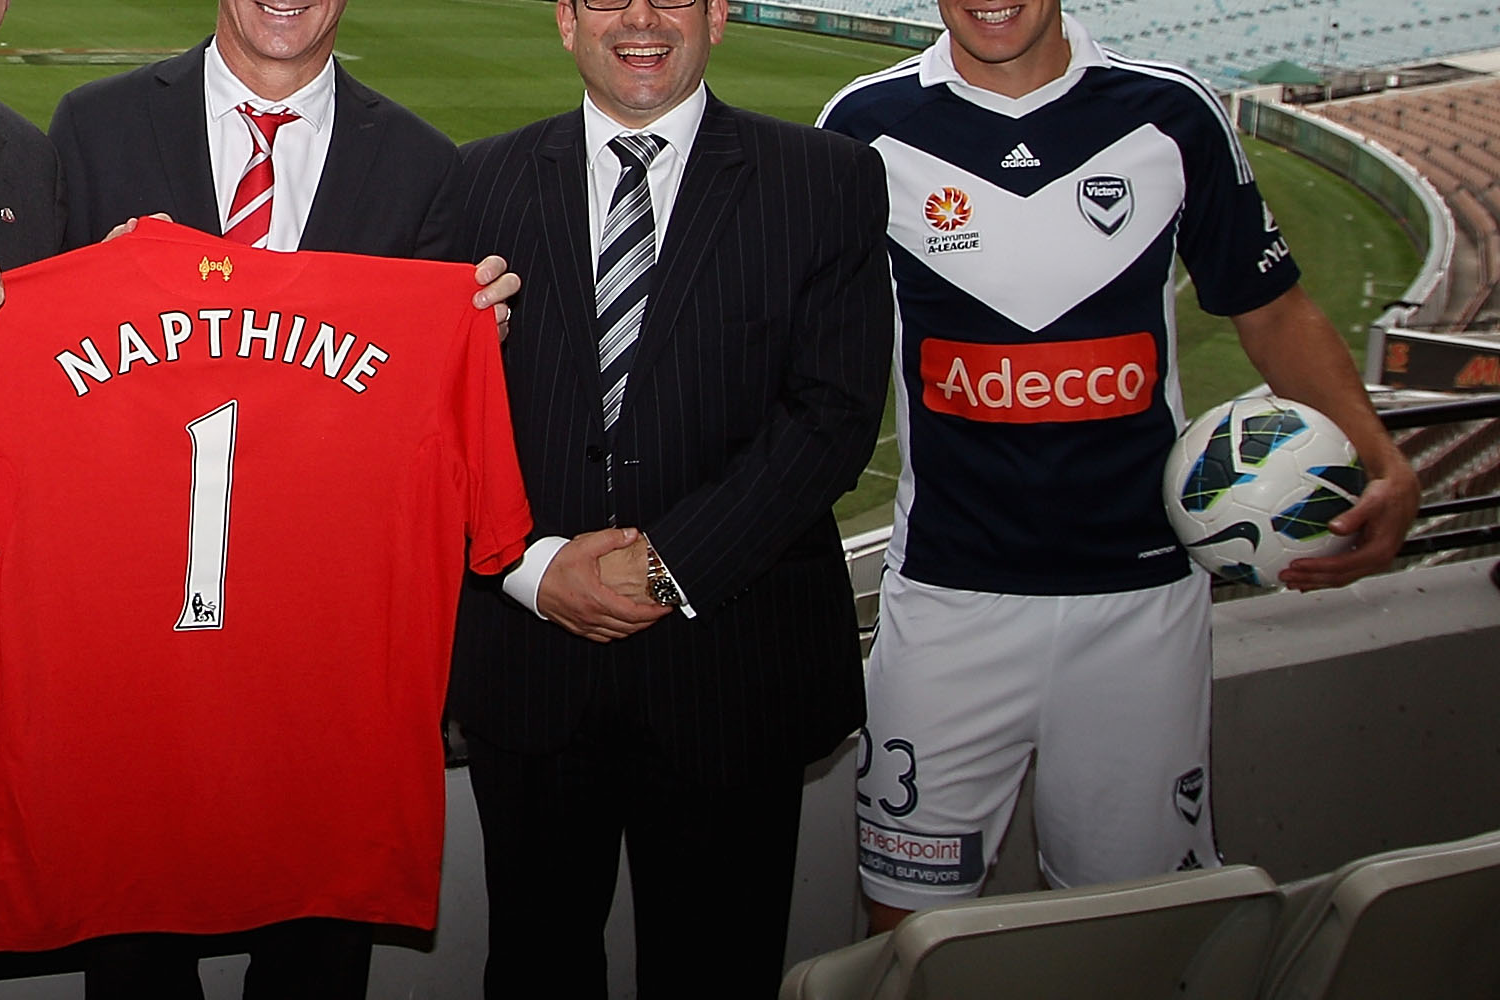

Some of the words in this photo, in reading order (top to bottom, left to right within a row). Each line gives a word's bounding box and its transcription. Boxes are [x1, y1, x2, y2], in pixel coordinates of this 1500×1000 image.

[1001, 158, 1041, 168] adidas
[1086, 186, 1124, 198] Victory
[941, 232, 979, 243] HYUNDAI
[928, 240, 980, 254] A-LEAGUE
[210, 261, 223, 271] 96
[54, 308, 390, 397] NAPTHINE
[936, 357, 1145, 408] Adecco
[173, 399, 238, 630] 1
[896, 865, 960, 883] surveyors
